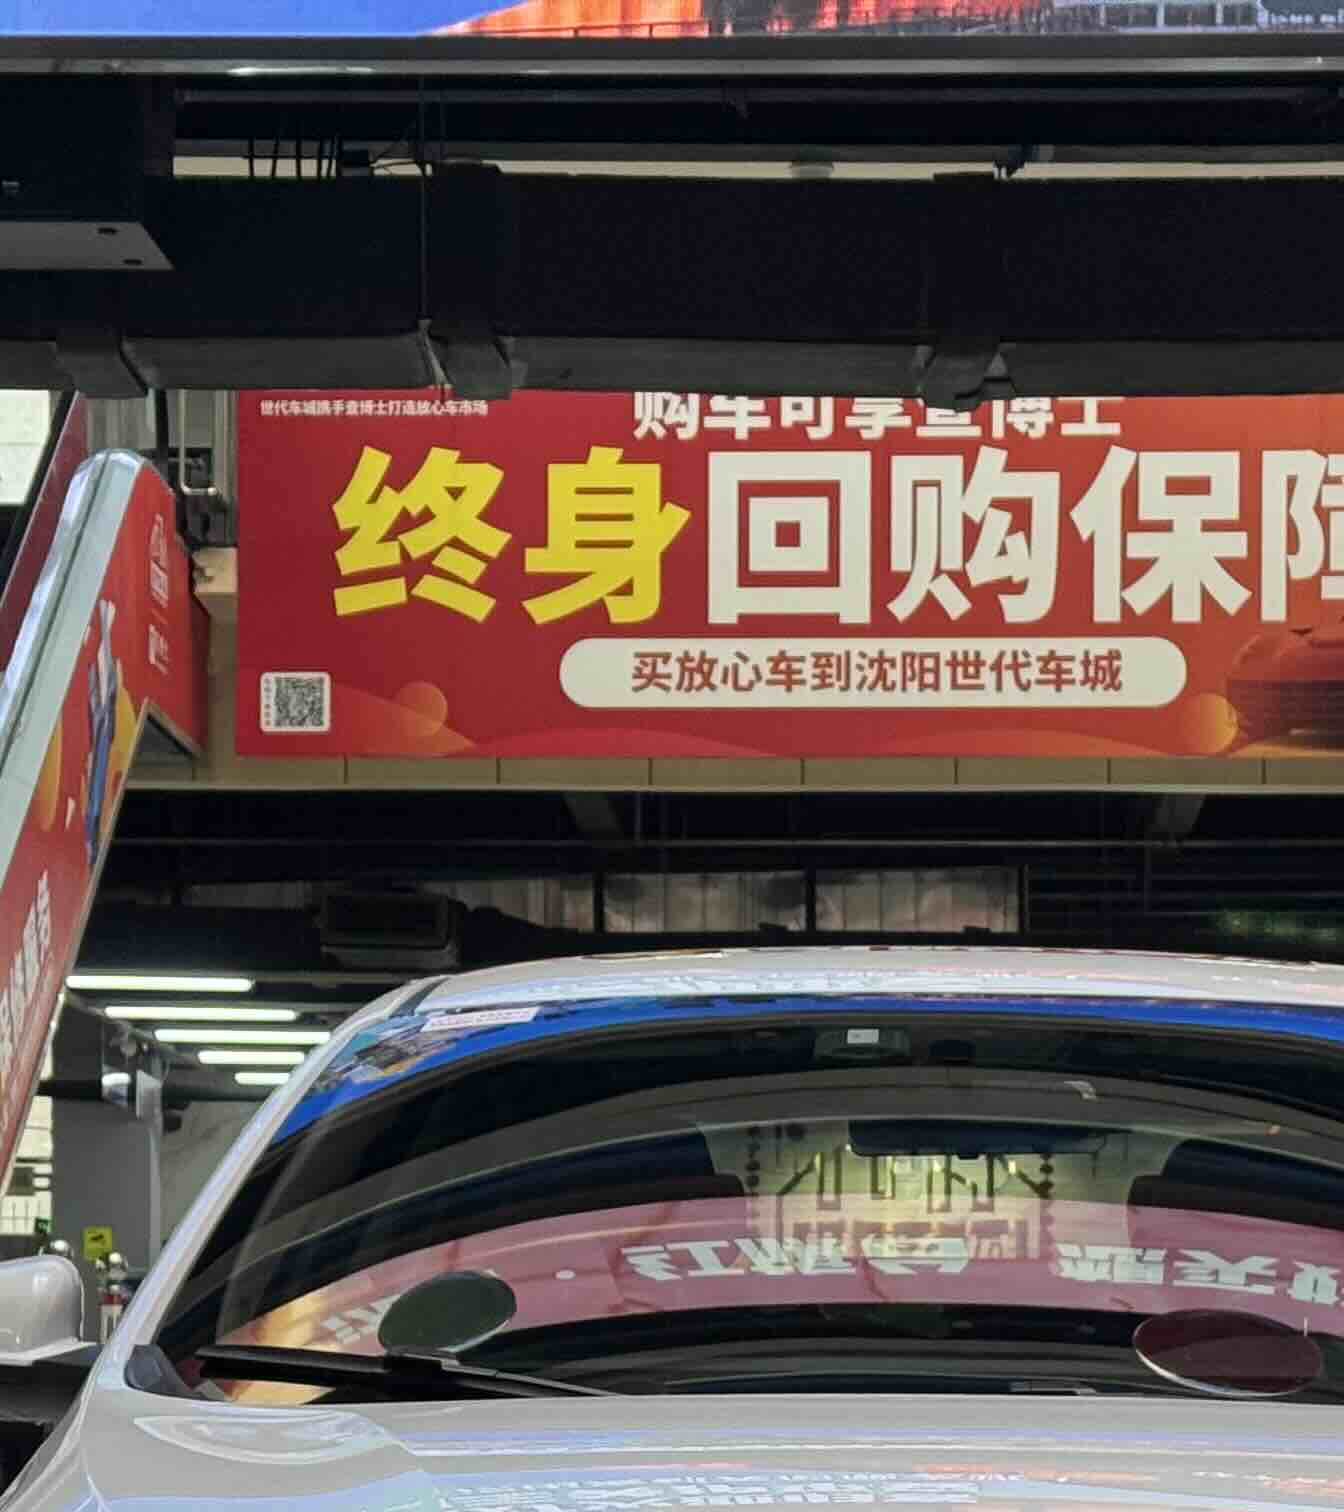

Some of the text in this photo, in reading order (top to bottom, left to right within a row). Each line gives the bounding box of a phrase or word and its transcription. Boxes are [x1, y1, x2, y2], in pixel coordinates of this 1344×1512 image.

[630, 648, 1123, 695] 买放心车到沈阳世代车城
